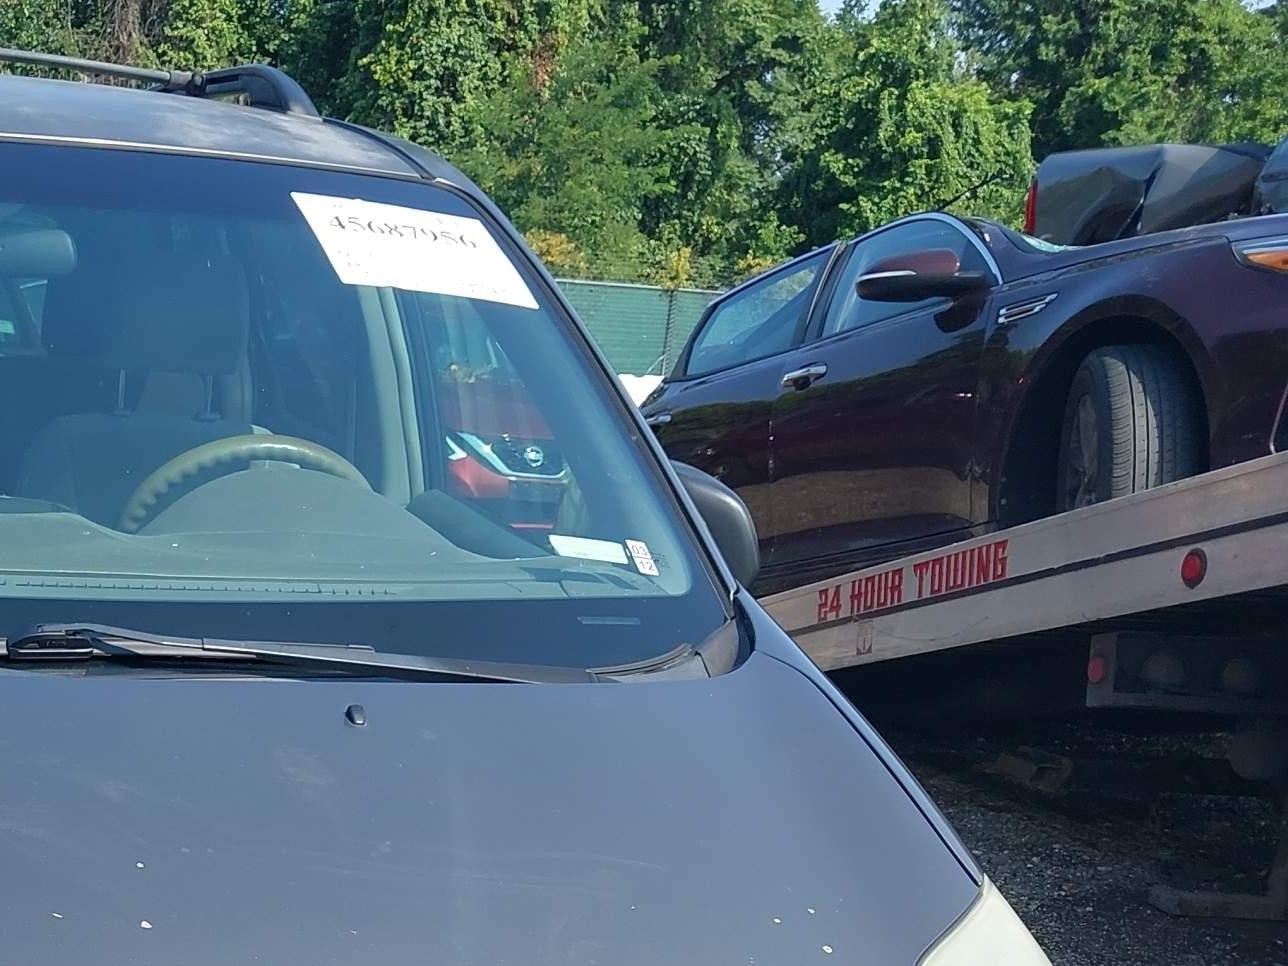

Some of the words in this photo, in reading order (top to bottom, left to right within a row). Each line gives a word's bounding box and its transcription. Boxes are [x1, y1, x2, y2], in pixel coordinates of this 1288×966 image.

[329, 215, 478, 248] 45687956
[817, 584, 843, 622] 24
[849, 567, 904, 616] HOUR
[913, 540, 1008, 598] TOWING
